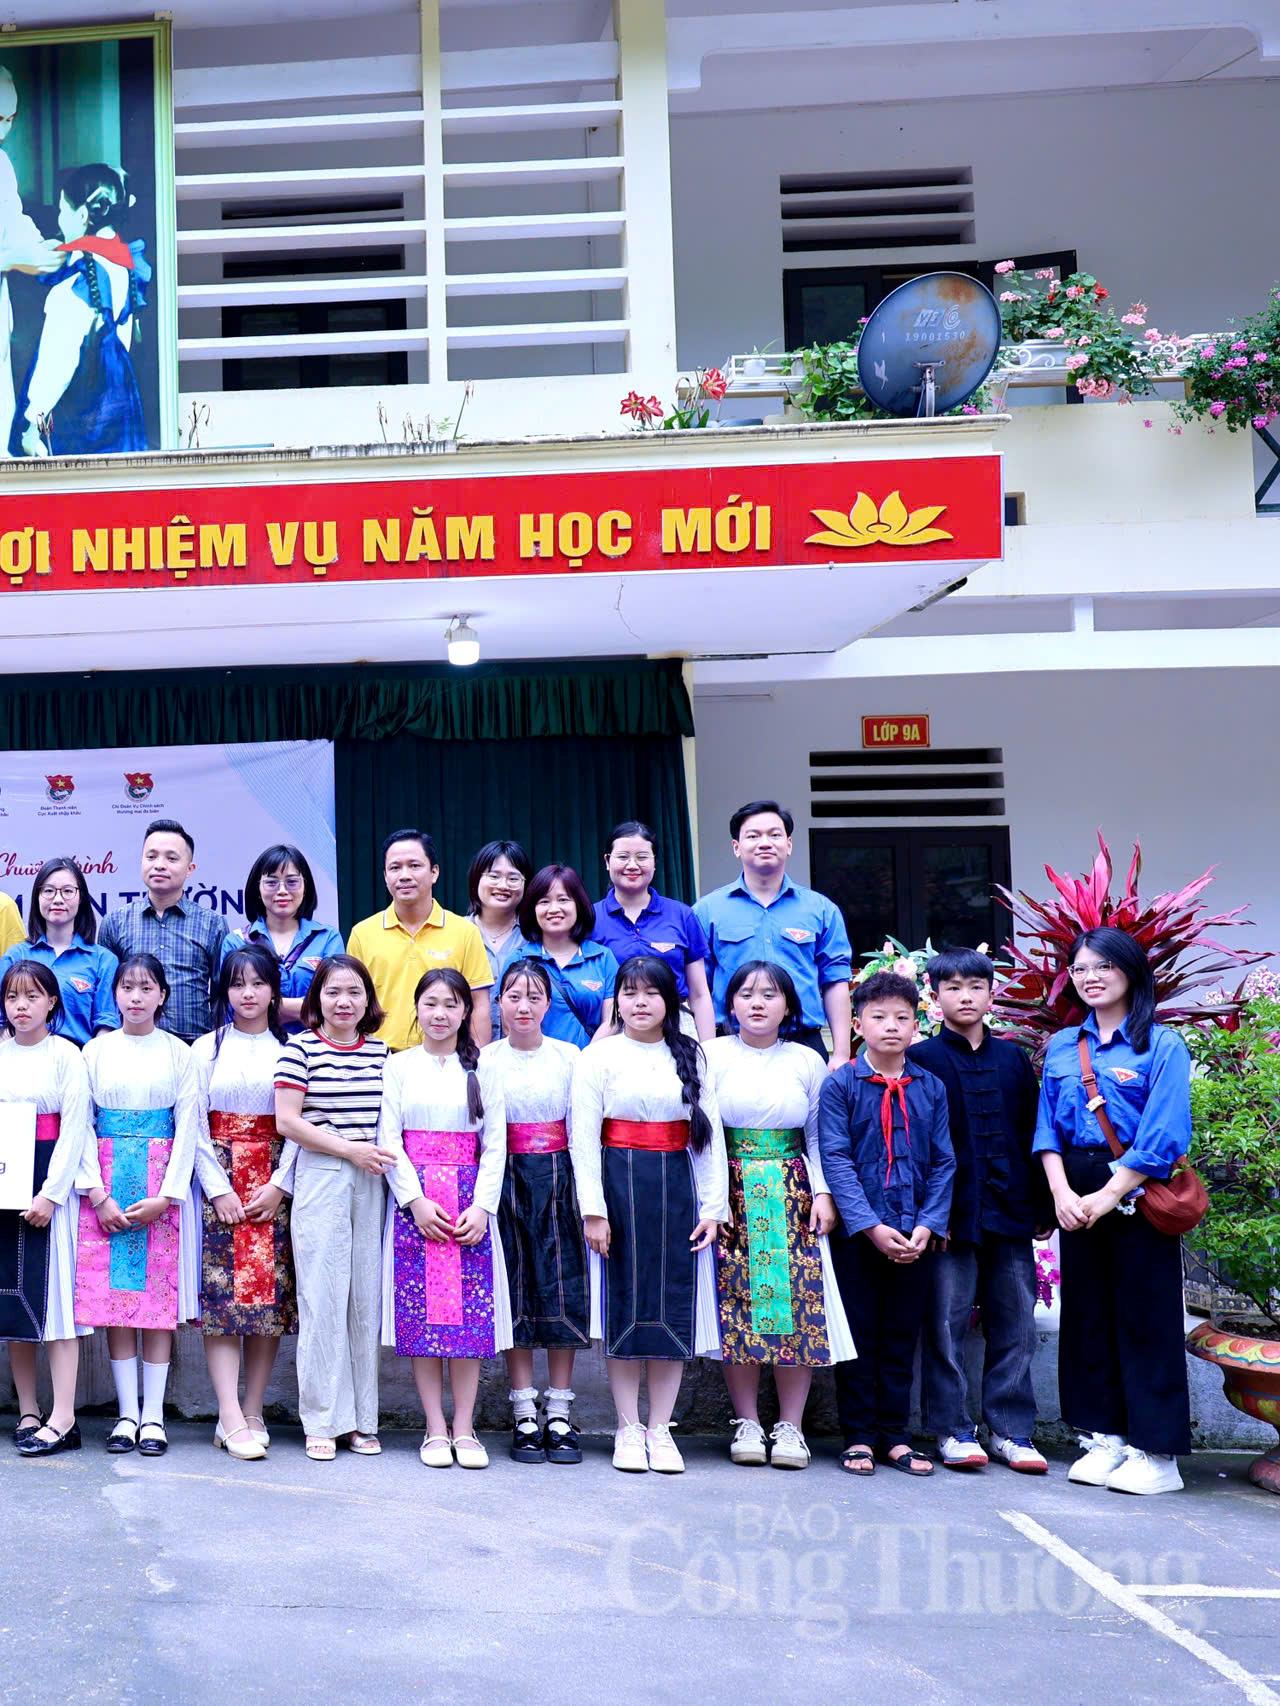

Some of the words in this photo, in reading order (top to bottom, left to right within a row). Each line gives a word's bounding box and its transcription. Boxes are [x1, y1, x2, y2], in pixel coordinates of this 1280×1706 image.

[72, 514, 247, 579] NHIỆM
[266, 520, 338, 576] VỤ
[362, 505, 495, 563] NĂM
[519, 509, 633, 568] HỌC
[660, 494, 772, 555] MỚI
[873, 720, 899, 741] LỚP
[902, 724, 921, 741] 9A
